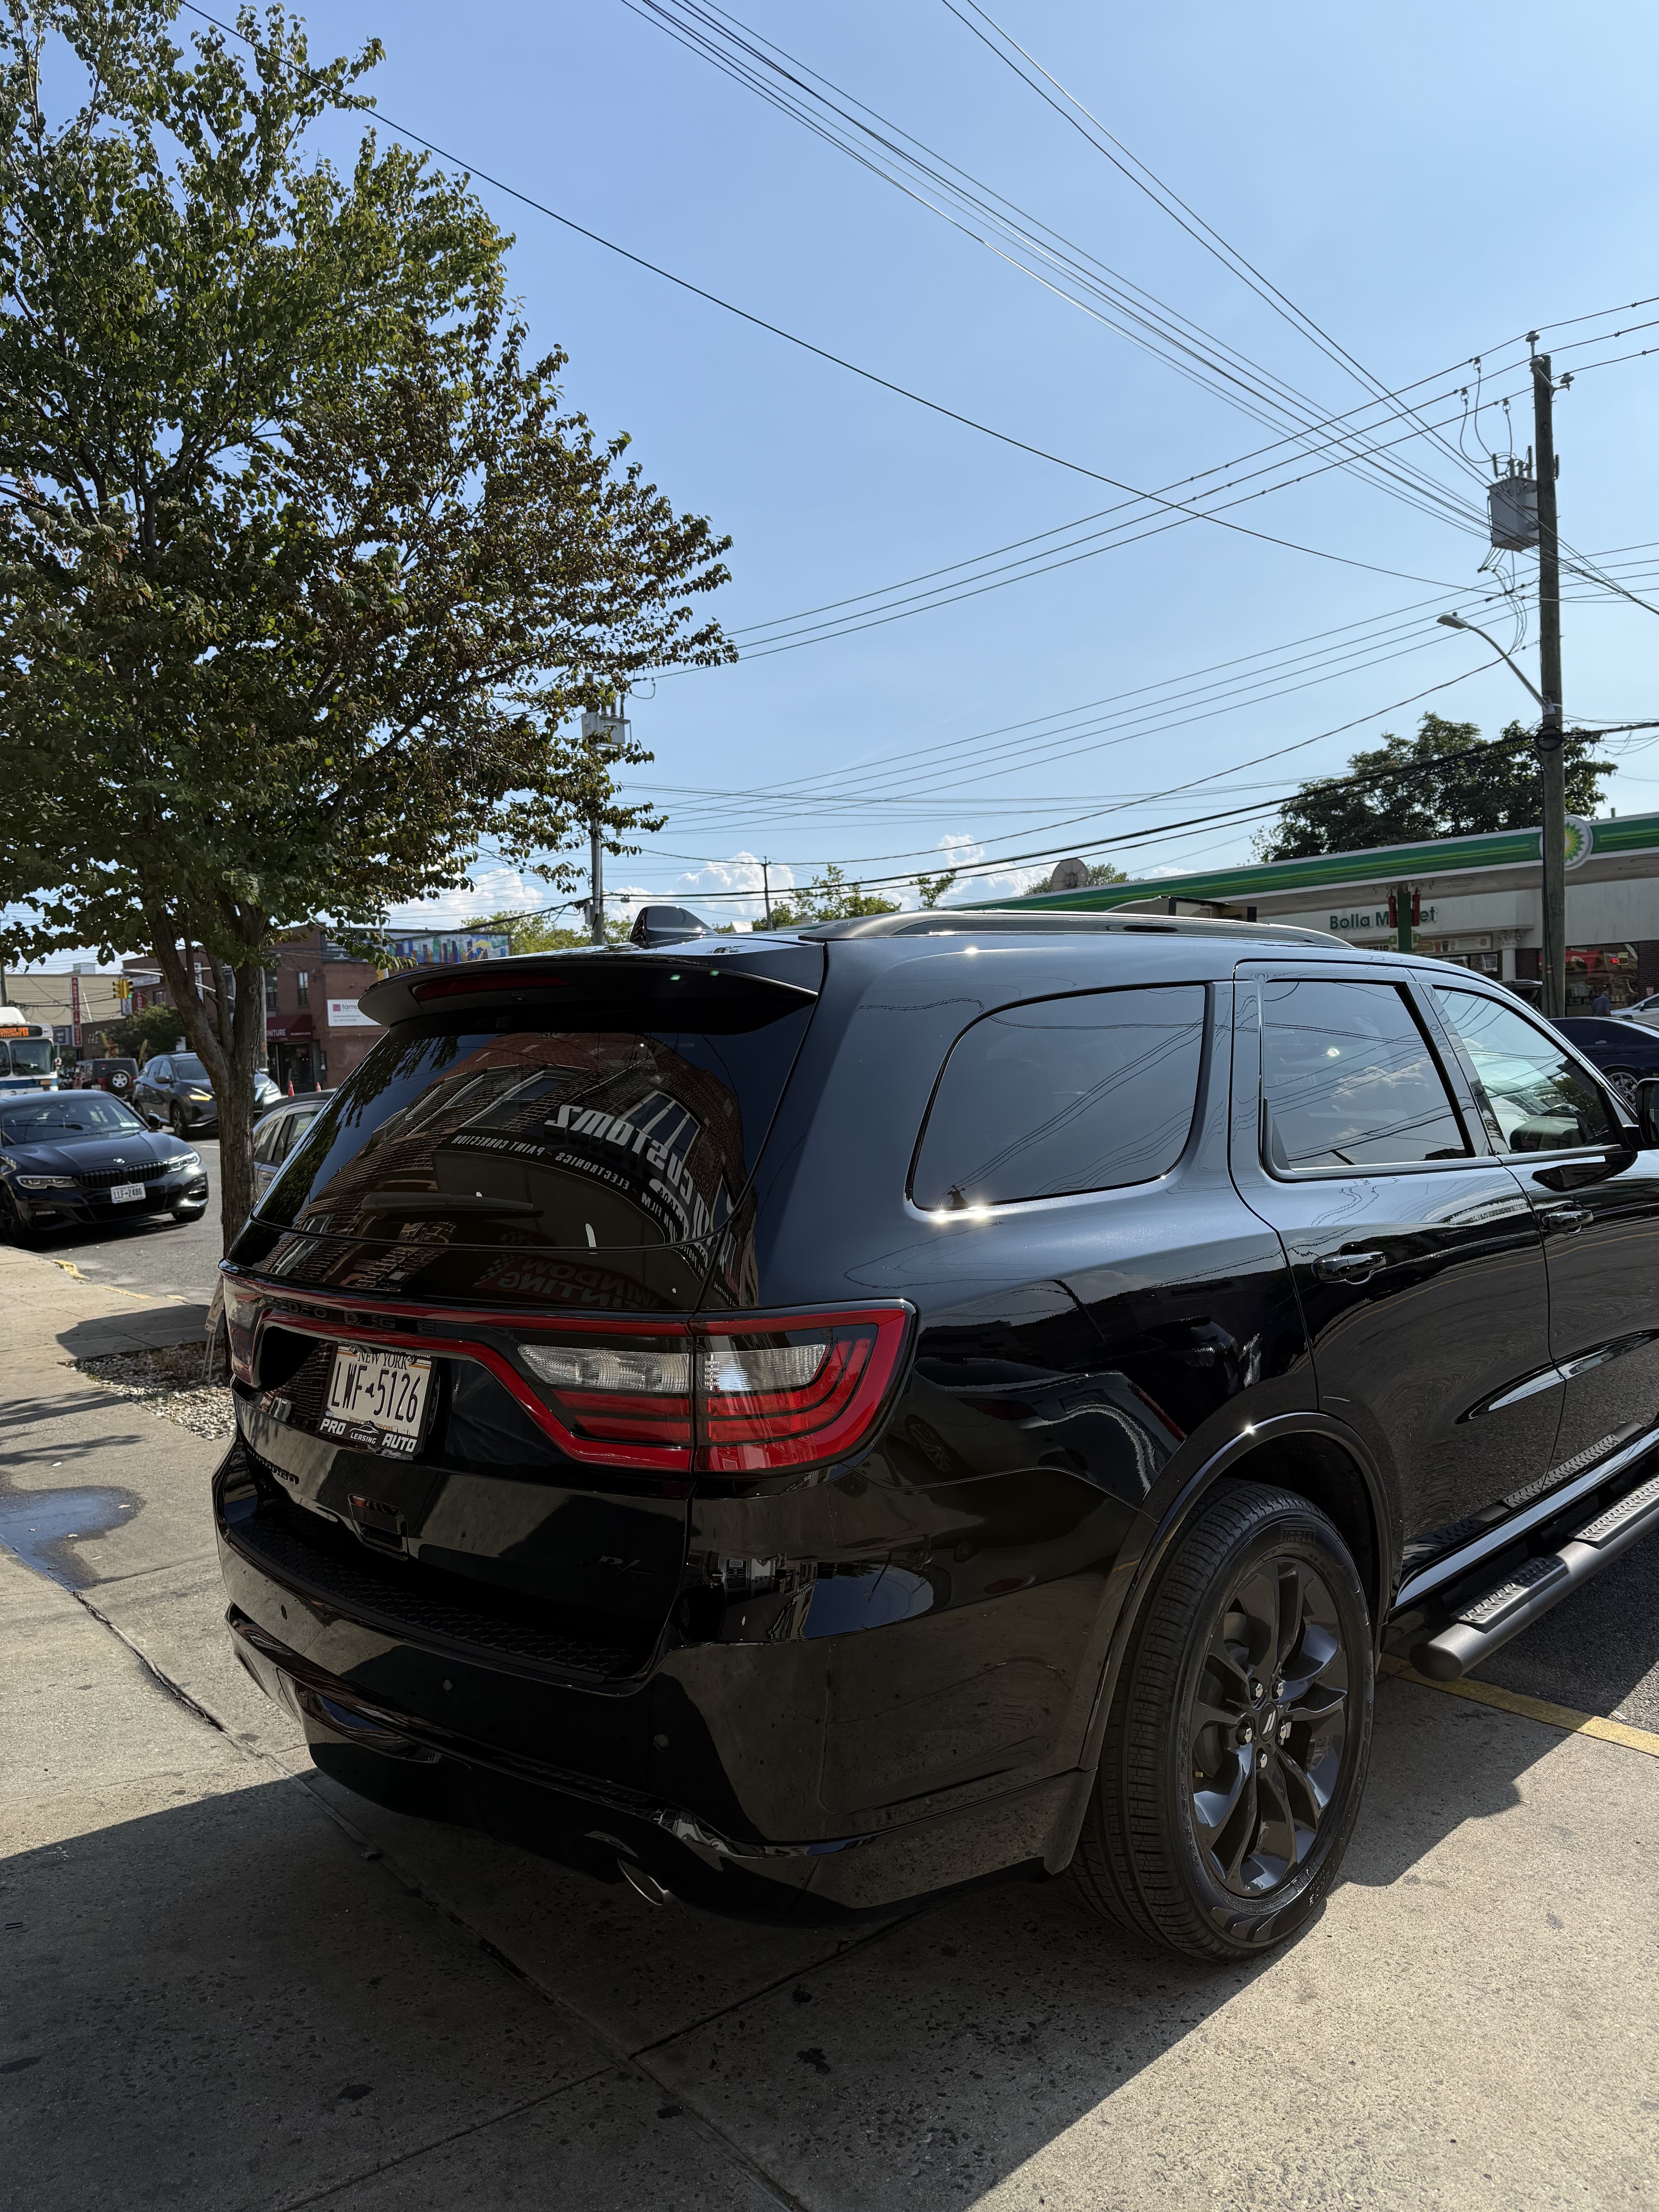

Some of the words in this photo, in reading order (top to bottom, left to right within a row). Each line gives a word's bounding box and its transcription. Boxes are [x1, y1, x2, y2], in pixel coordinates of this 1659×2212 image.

[1330, 914, 1370, 929] Bolla
[1376, 906, 1435, 926] Met
[288, 1302, 436, 1334] DODGE
[358, 1352, 381, 1366] NEW
[382, 1353, 407, 1370] YORK
[320, 1418, 346, 1436] PRO
[381, 1433, 417, 1452] AUTO
[350, 1432, 377, 1444] LEASING
